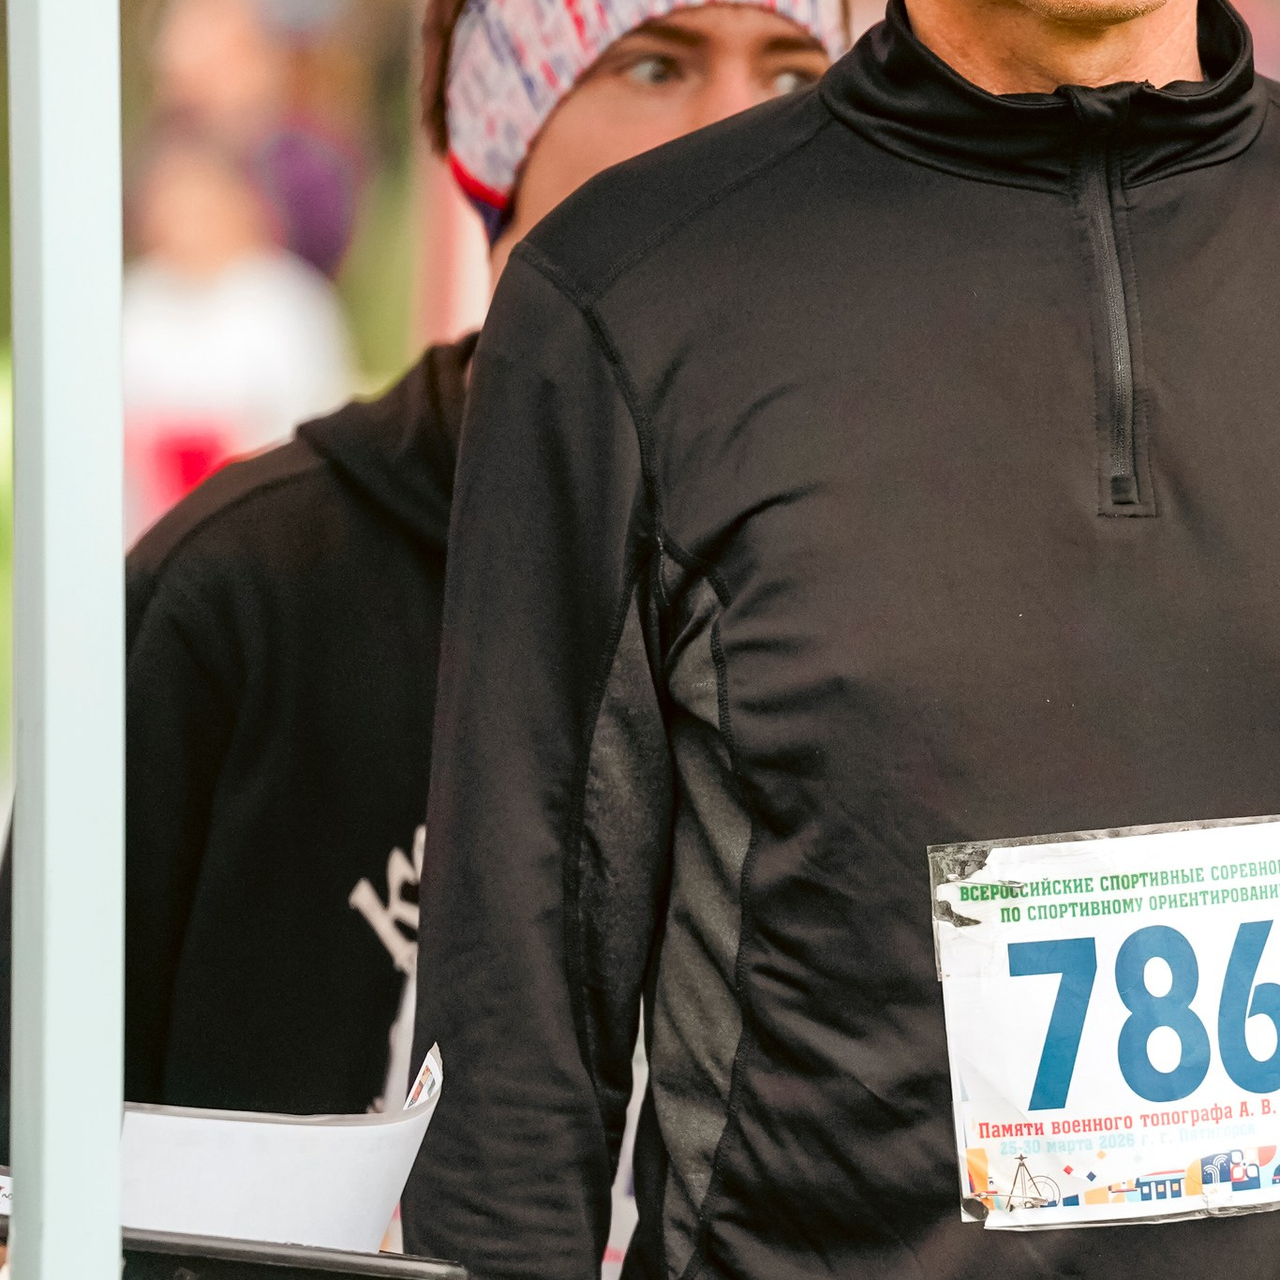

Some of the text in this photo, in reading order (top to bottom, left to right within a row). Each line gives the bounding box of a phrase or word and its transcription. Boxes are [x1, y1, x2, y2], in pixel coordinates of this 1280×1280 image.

[960, 877, 1094, 902] ВСЕРОССИЙСКИЕ
[1100, 867, 1205, 892] СПОРТИВНЫЕ
[1000, 906, 1021, 923] ПО
[1027, 897, 1143, 921] СПОРТИВНОМУ
[979, 1122, 1044, 1139] Памяти
[1051, 1115, 1133, 1135] военного
[1140, 1103, 1233, 1127] топографа
[1239, 1101, 1254, 1117] А.
[1261, 1099, 1276, 1115] В.
[1000, 1139, 1041, 1156] 25-30
[1047, 1137, 1093, 1155] марта
[1100, 1133, 1135, 1150] 2026
